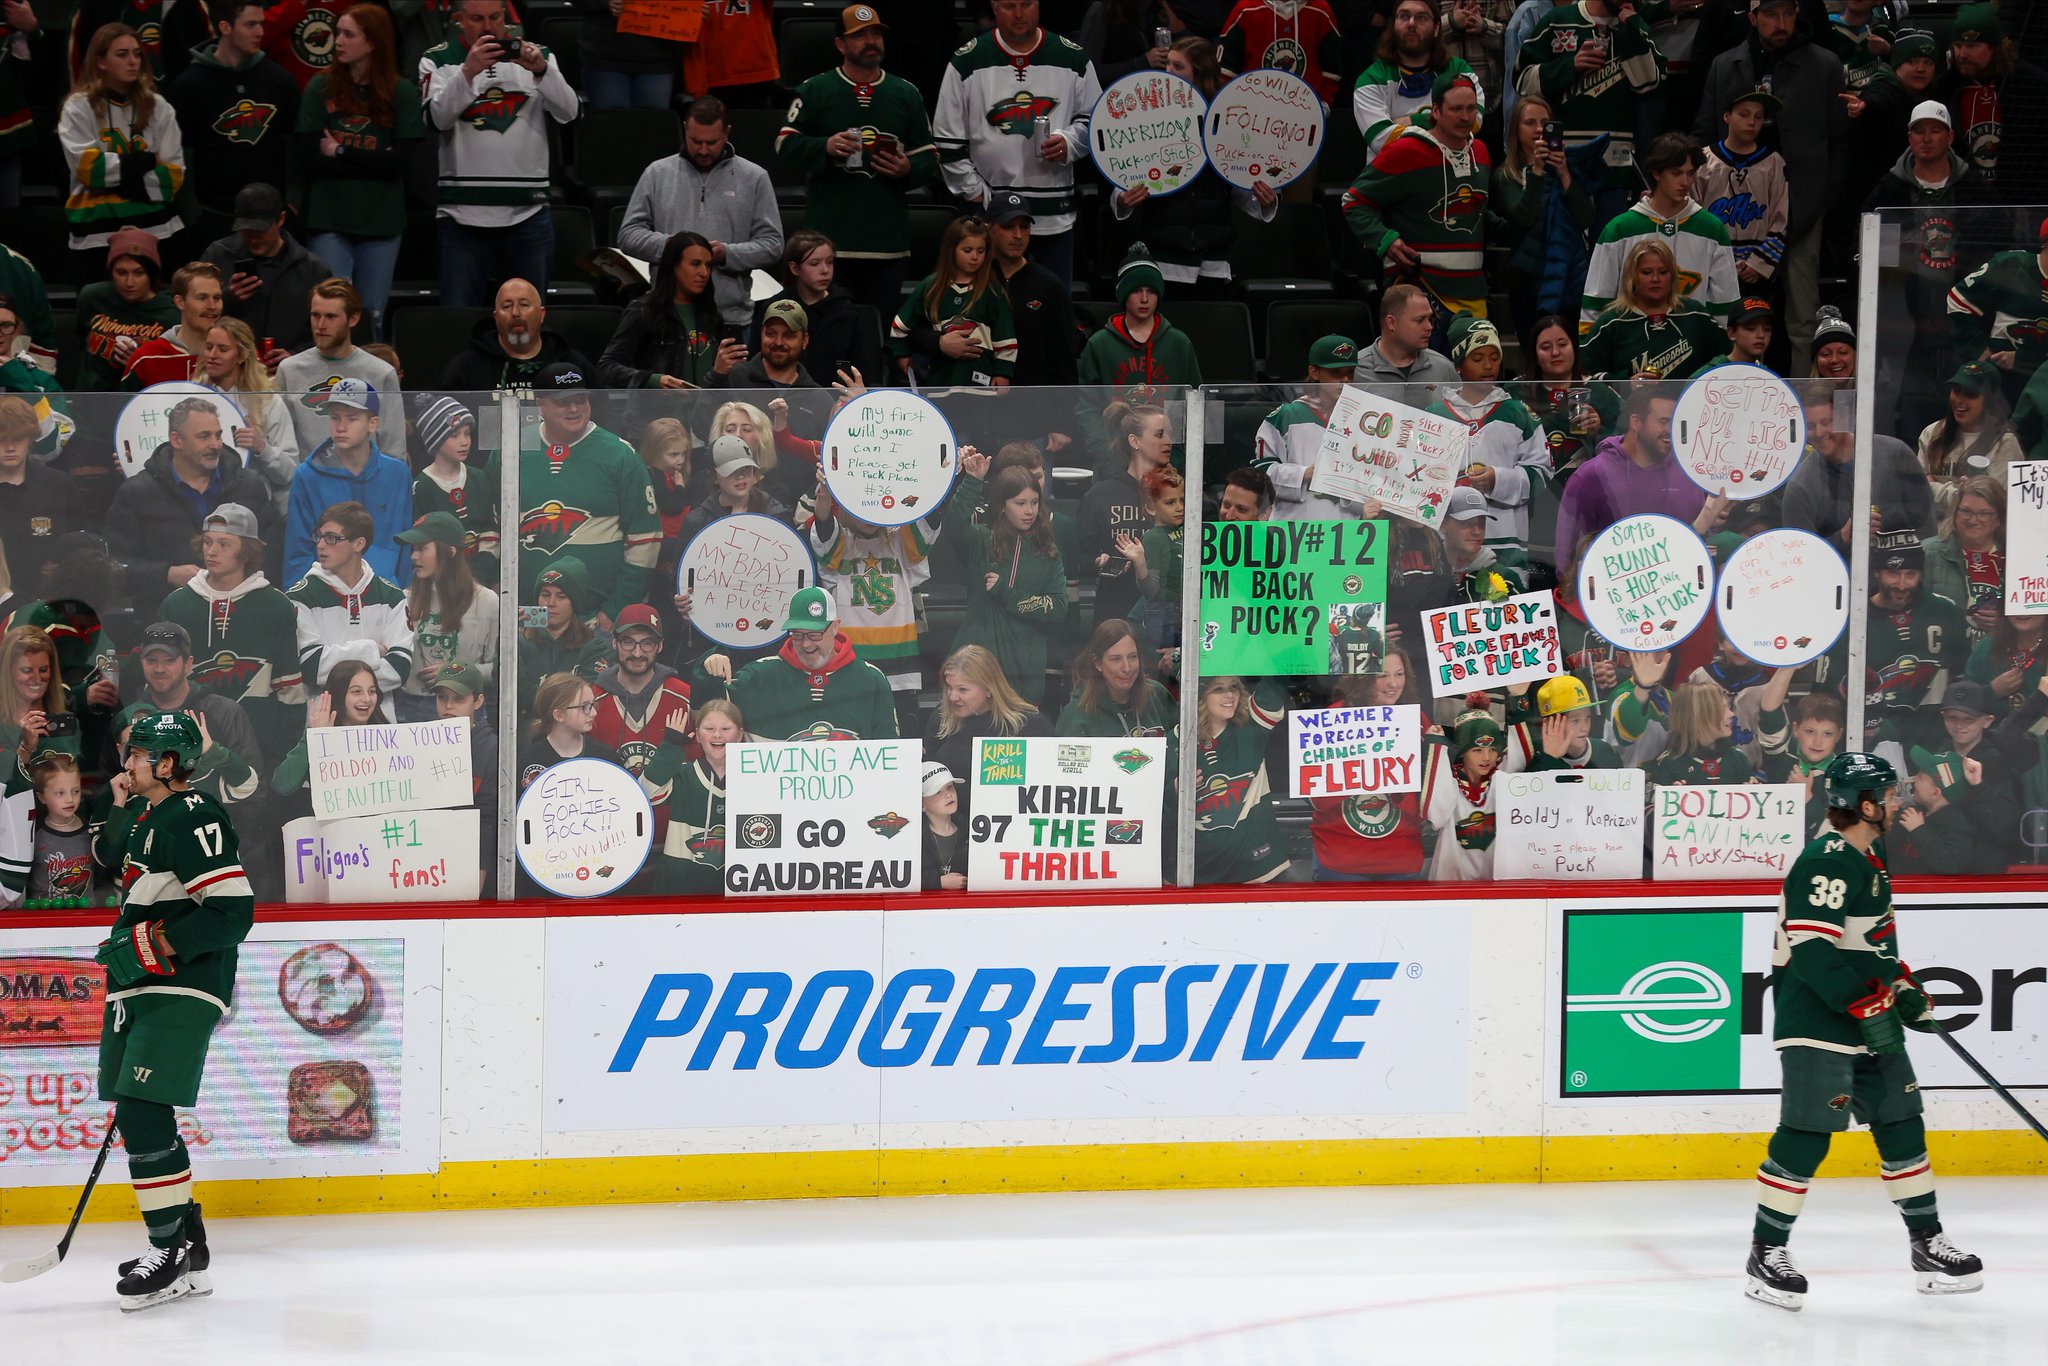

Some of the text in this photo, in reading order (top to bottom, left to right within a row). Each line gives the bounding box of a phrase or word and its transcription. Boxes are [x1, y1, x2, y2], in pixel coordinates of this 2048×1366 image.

[1226, 106, 1305, 142] FOLIGNO
[1231, 165, 1248, 173] BMO
[90, 313, 164, 338] Minnesota
[880, 428, 914, 440] game
[1359, 410, 1394, 439] GO
[889, 442, 902, 453] I
[896, 460, 918, 472] get
[864, 483, 892, 496] #36
[2021, 484, 2044, 510] My
[724, 525, 792, 562] IT'S
[1201, 521, 1308, 569] BOLDY
[698, 543, 791, 585] MY BDAY
[1603, 537, 1671, 579] BUNNY
[696, 565, 787, 601] CAN I GET
[1252, 571, 1314, 600] BACK
[705, 591, 717, 605] A
[726, 594, 773, 614] PUCK
[1642, 603, 1655, 619] A
[1656, 582, 1700, 617] PUCK
[2010, 592, 2019, 604] A
[1231, 605, 1320, 646] PUCK?
[1347, 643, 1369, 651] BOLDY
[1438, 626, 1556, 662] TRADE FLOWER
[1346, 652, 1371, 675] 12
[1440, 658, 1479, 685] FOR
[153, 723, 183, 731] TOYOTA
[1297, 706, 1393, 729] WEATHER
[314, 724, 462, 758] I THINK YOU'RE
[1300, 727, 1400, 749] FORECAST:
[740, 746, 898, 773] EWING AVE
[983, 742, 1023, 763] KIRILL
[1303, 740, 1395, 764] CHANCE OF
[319, 755, 415, 783] BOLD(Y) AND
[430, 756, 468, 782] #12
[983, 765, 1024, 783] THRILL
[1299, 753, 1415, 796] FLEURY
[323, 779, 420, 814] BEAUTIFUL
[541, 773, 604, 799] GIRL
[779, 774, 854, 801] PROUD
[543, 798, 621, 824] GOALIES
[1018, 785, 1123, 815] KIRILL
[1662, 788, 1796, 820] BOLDY 12
[1358, 823, 1385, 834] WILD
[1511, 806, 1559, 828] Boldy
[143, 828, 155, 856] A
[194, 822, 223, 858] 17
[381, 819, 423, 849] #1
[796, 819, 846, 849] GO
[971, 814, 1096, 848] 97 THE
[1662, 819, 1719, 846] CAN
[296, 837, 370, 884] Foligno's
[1553, 844, 1562, 853] I
[1569, 842, 1597, 853] please
[1605, 842, 1624, 851] have
[1662, 846, 1678, 867] A
[389, 858, 447, 889] fans!
[555, 872, 574, 880] BMO
[725, 860, 912, 893] GAUDREAU
[1000, 851, 1118, 881] THRILL
[1809, 875, 1847, 910] 38
[607, 961, 1399, 1073] PROGRESSIVE
[26, 1073, 93, 1115] up
